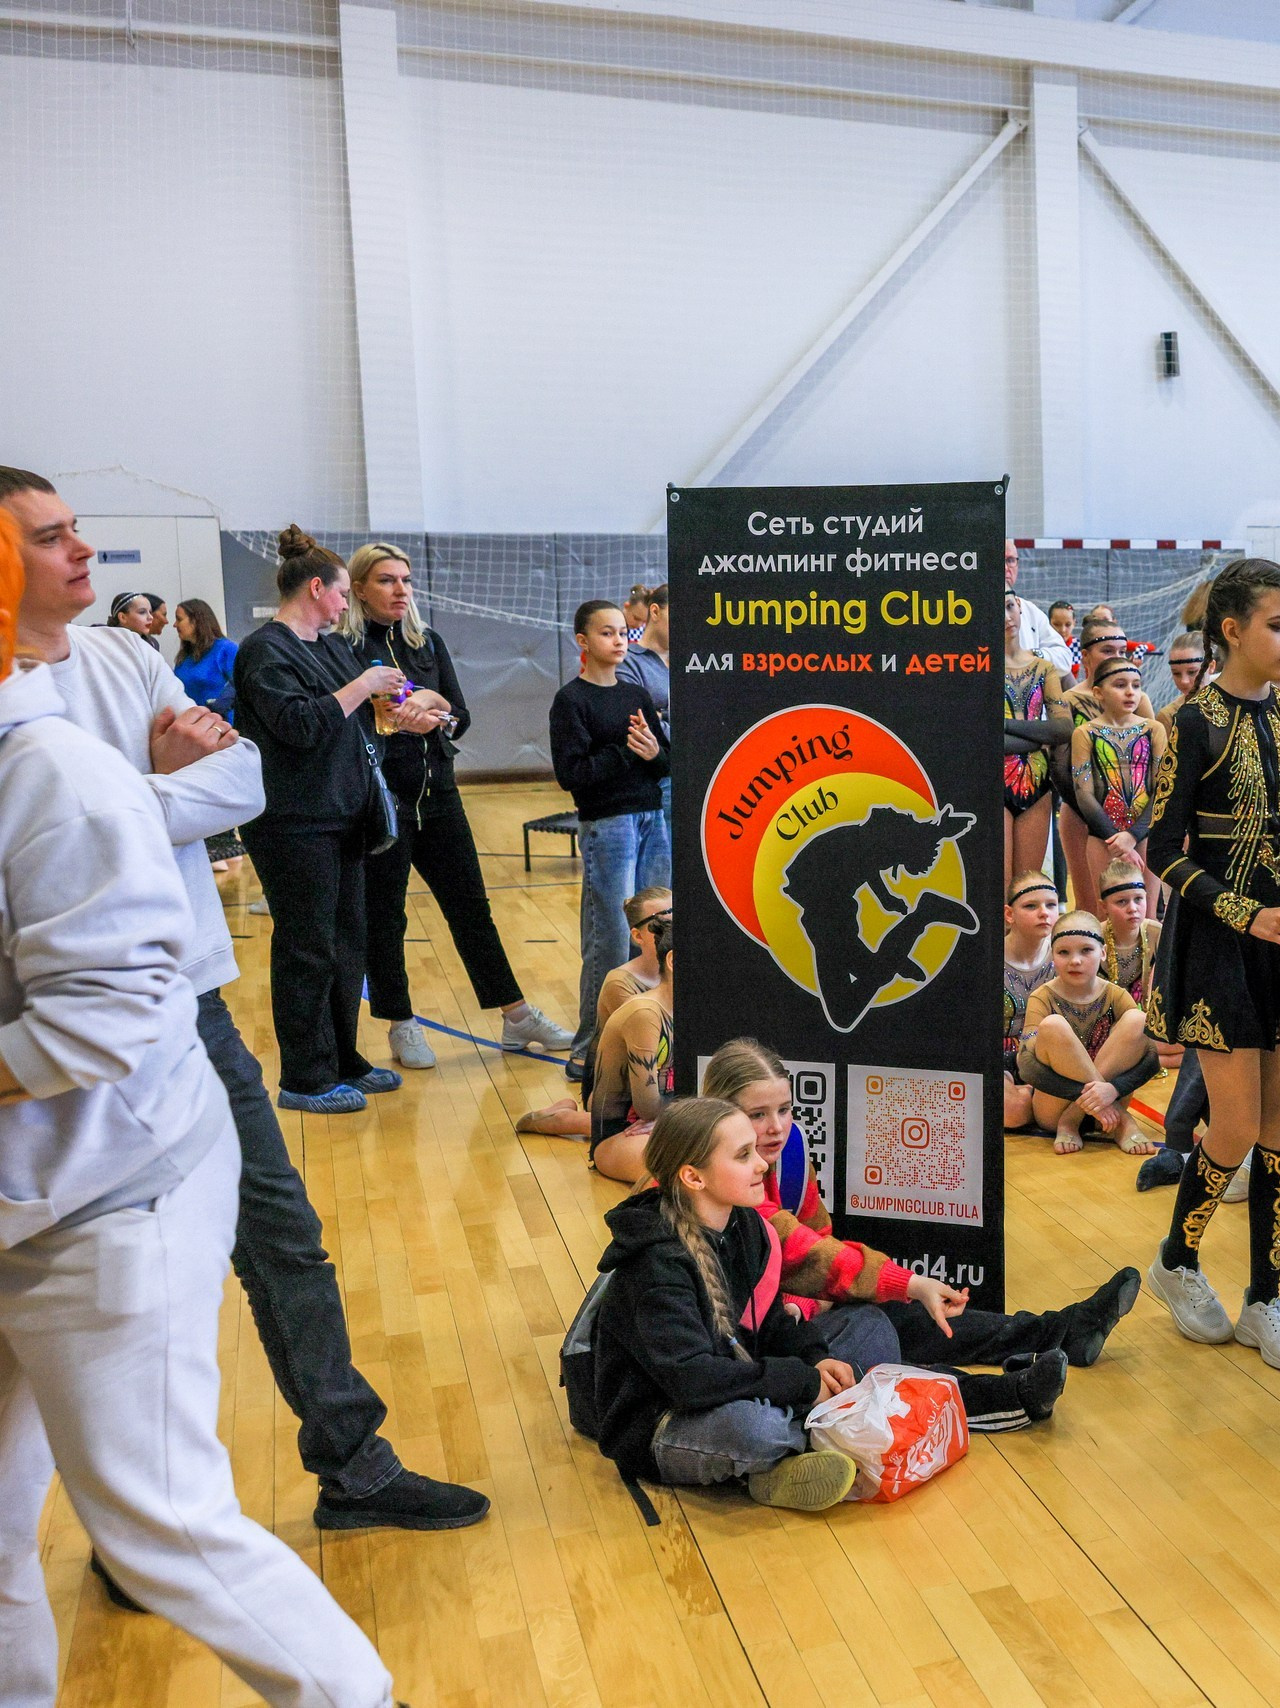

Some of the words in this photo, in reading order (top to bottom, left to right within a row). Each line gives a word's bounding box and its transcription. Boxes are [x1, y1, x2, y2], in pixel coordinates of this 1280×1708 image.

[747, 511, 815, 536] Сеть
[823, 507, 924, 540] студий
[698, 553, 837, 576] джампинг
[845, 548, 978, 578] фитнеса
[706, 590, 867, 635] Jumping
[880, 589, 973, 626] Club
[685, 652, 734, 674] для
[742, 652, 873, 678] взрослых
[881, 653, 897, 672] и
[905, 646, 991, 676] детей
[716, 724, 854, 841] Jumping
[775, 786, 840, 841] Club
[850, 1194, 979, 1220] @JUMPINGCLUB.TULA
